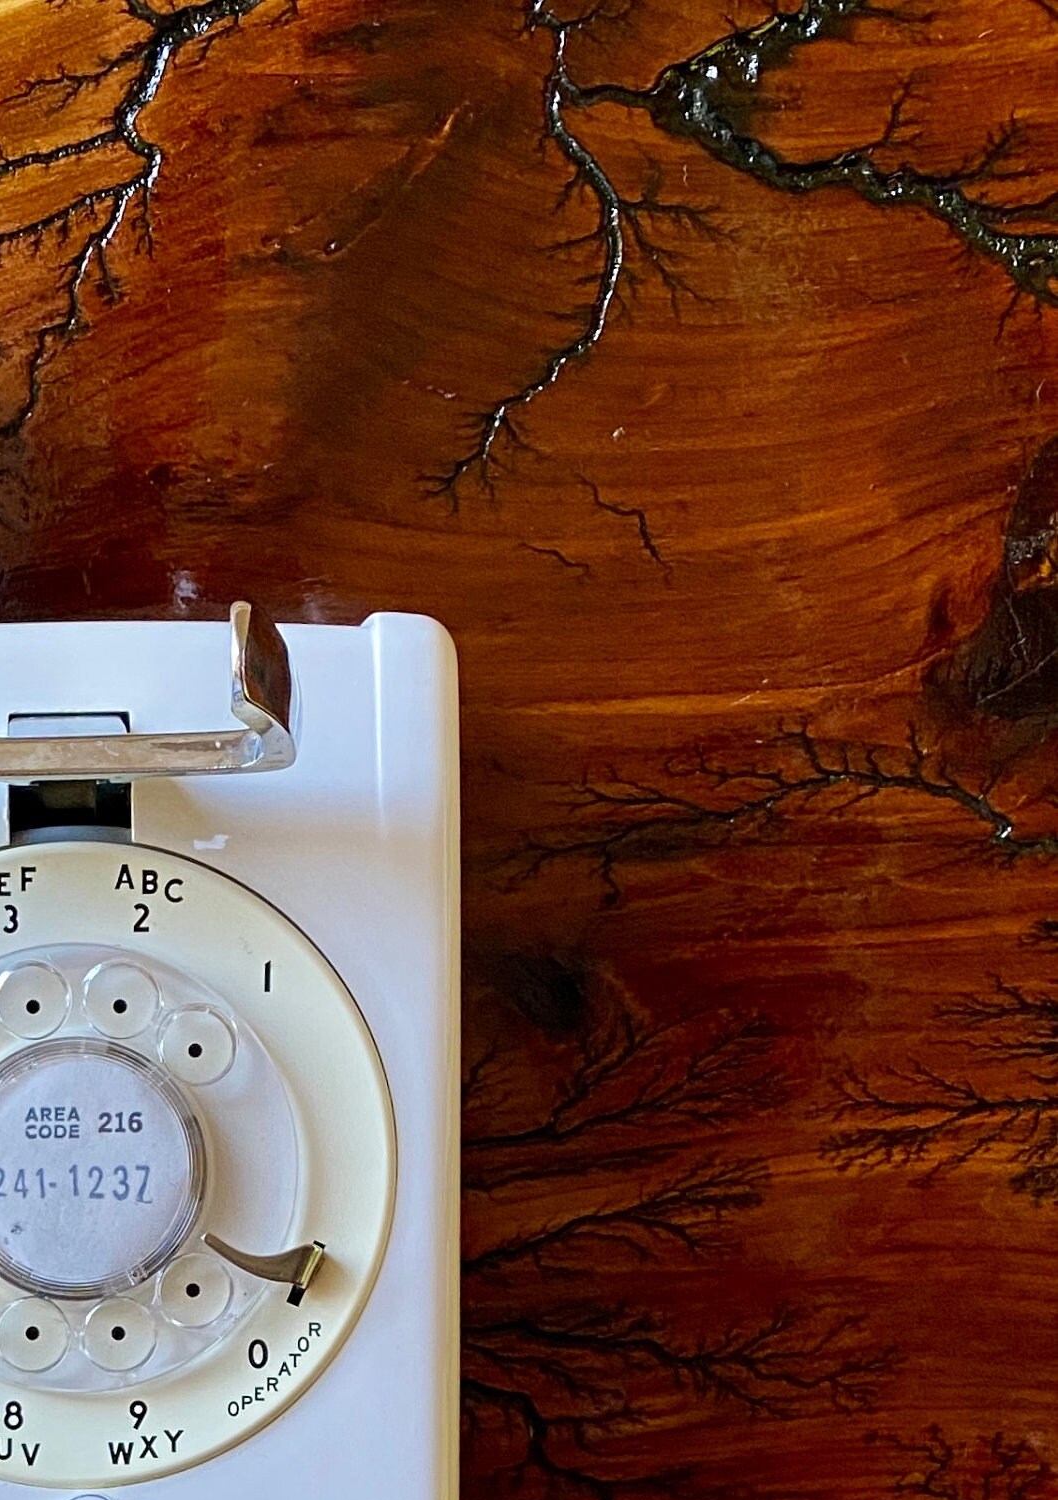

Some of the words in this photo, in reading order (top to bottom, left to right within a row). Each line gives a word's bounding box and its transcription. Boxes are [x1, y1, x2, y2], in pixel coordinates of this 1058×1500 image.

[114, 864, 185, 903] ABC
[3, 904, 19, 934] 3
[133, 903, 150, 933] 2
[25, 1106, 80, 1123] AREA
[98, 1111, 143, 1134] 216
[25, 1124, 80, 1140] CODE
[227, 1321, 322, 1417] OPERATOR
[3, 1400, 24, 1431] 8
[129, 1400, 148, 1430] 9
[108, 1428, 185, 1465] WXY
